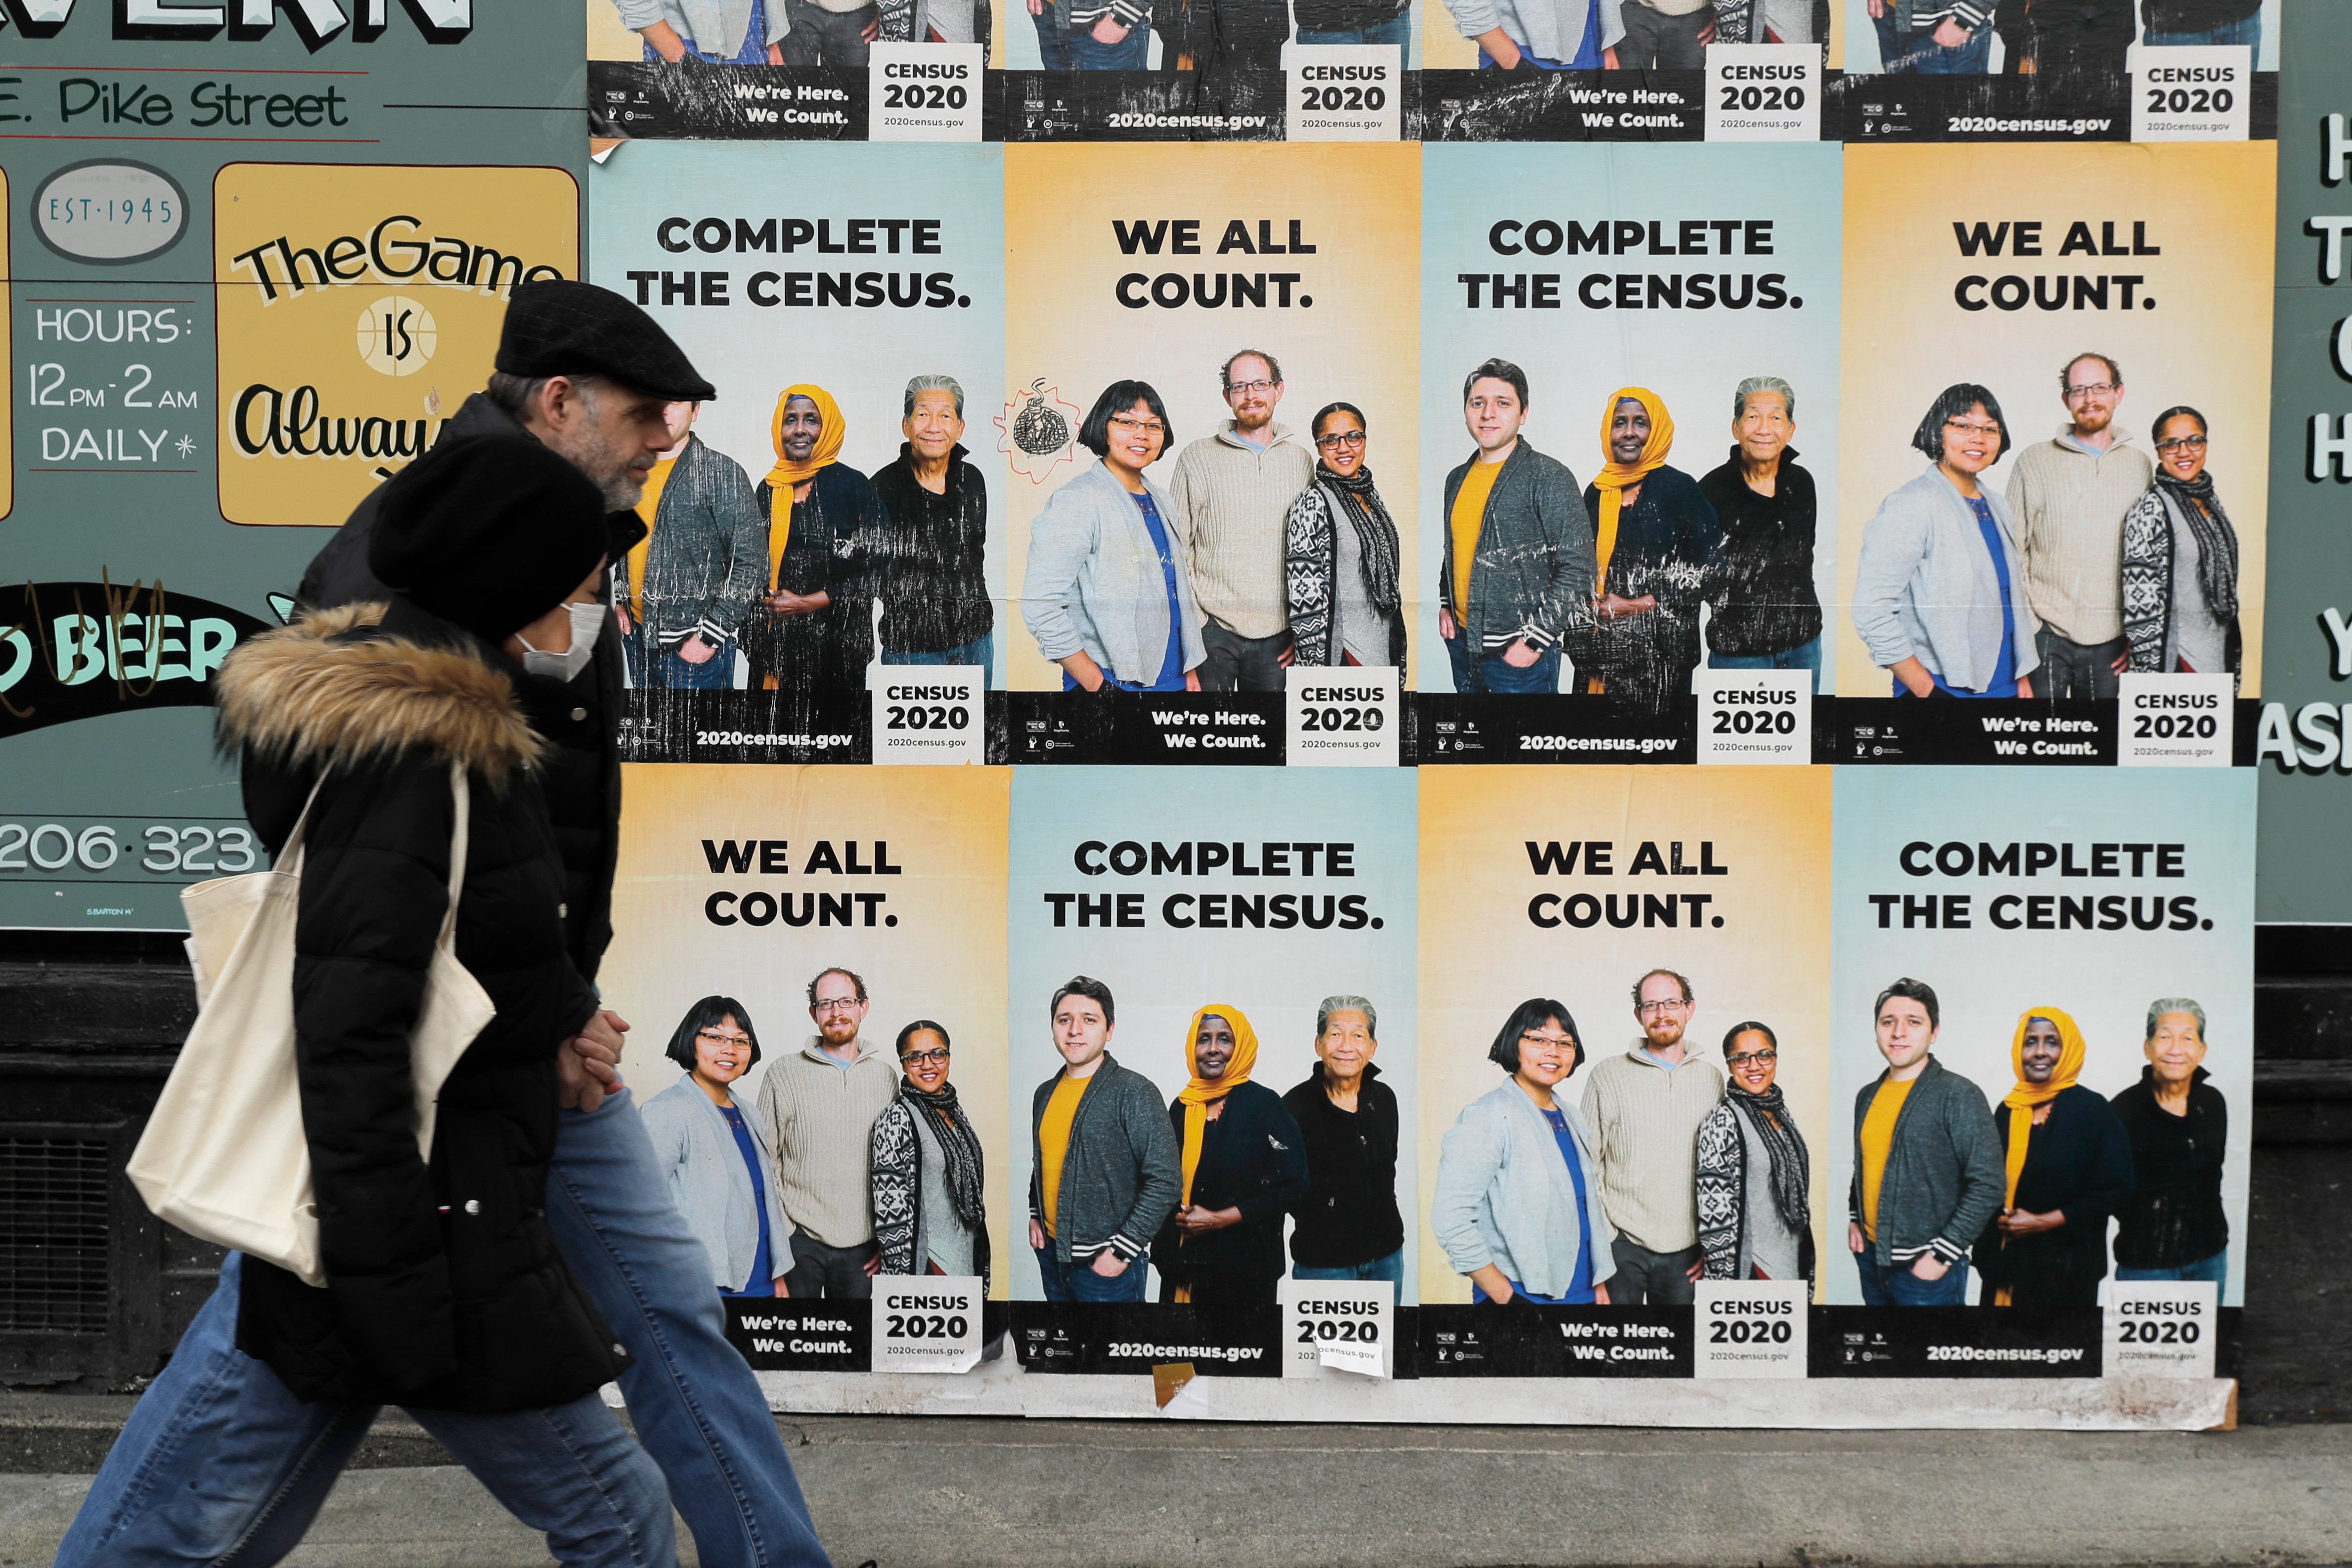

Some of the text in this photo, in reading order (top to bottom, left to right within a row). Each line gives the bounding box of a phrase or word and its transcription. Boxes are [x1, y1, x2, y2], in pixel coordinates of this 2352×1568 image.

[885, 64, 968, 79] CENSUS
[1302, 66, 1386, 80] CENSUS
[1722, 66, 1806, 80] CENSUS
[2148, 68, 2234, 82] CENSUS
[797, 86, 849, 101] Here.
[884, 85, 967, 109] 2020
[1301, 87, 1385, 110] 2020
[1634, 89, 1685, 104] Here.
[1721, 87, 1804, 110] 2020
[2148, 89, 2232, 113] 2020
[190, 82, 348, 127] Street
[746, 108, 848, 125] We Count.
[885, 118, 964, 128] 2020census.gov
[1109, 113, 1266, 131] 2020census.gov
[1302, 120, 1382, 129] 2020census.gov
[1581, 112, 1684, 128] We Count.
[1721, 120, 1801, 129] 2020census.gov
[1948, 117, 2111, 135] 2020census.gov
[2147, 123, 2229, 132] 2020census.gov
[657, 218, 941, 254] COMPLETE
[1112, 220, 1316, 254] WE ALL
[1489, 220, 1773, 255] COMPLETE
[1953, 222, 2160, 256] WE ALL
[627, 271, 971, 308] THE CENSUS.
[1116, 273, 1312, 309] COUNT.
[1458, 274, 1803, 309] THE CENSUS.
[1955, 275, 2155, 311] COUNT.
[36, 308, 192, 344] HOURS:
[385, 309, 412, 361] IS
[53, 613, 237, 685] BEER
[887, 686, 969, 700] CENSUS
[1301, 688, 1384, 701] CENSUS
[1713, 690, 1796, 704] CENSUS
[2135, 695, 2217, 708] CENSUS
[887, 706, 969, 729] 2020
[1215, 712, 1266, 725] Here.
[1301, 708, 1383, 731] 2020
[1713, 711, 1795, 734] 2020
[2046, 718, 2098, 732] Here.
[2134, 716, 2216, 738] 2020
[697, 731, 852, 749] 2020census.gov
[888, 739, 966, 748] 2020census.gov
[1164, 734, 1266, 748] We Count.
[1302, 741, 1380, 749] 2020census.gov
[1520, 736, 1677, 753] 2020census.gov
[1713, 743, 1792, 753] 2020census.gov
[1994, 741, 2098, 755] We Count.
[2134, 748, 2214, 757] 2020census.gov
[701, 840, 901, 874] WE ALL
[1074, 841, 1354, 876] COMPLETE
[1525, 842, 1728, 875] WE ALL
[1900, 842, 2184, 877] COMPLETE
[705, 892, 897, 927] COUNT.
[1044, 894, 1383, 929] THE CENSUS.
[1528, 894, 1724, 928] COUNT.
[1869, 895, 2213, 931] THE CENSUS.
[887, 1296, 968, 1310] CENSUS
[1298, 1300, 1379, 1315] CENSUS
[1710, 1301, 1792, 1314] CENSUS
[2121, 1302, 2201, 1315] CENSUS
[803, 1317, 852, 1331] Here.
[887, 1315, 967, 1338] 2020
[1297, 1320, 1378, 1343] 2020
[1624, 1324, 1675, 1338] Here.
[1710, 1321, 1791, 1343] 2020
[2119, 1321, 2199, 1343] 2020
[753, 1339, 851, 1353] We Count.
[888, 1347, 964, 1356] 2020census.gov
[1109, 1343, 1263, 1361] 2020census.gov
[1573, 1346, 1674, 1360] We Count.
[1927, 1346, 2084, 1363] 2020census.gov
[1711, 1352, 1789, 1361] 2020census.gov
